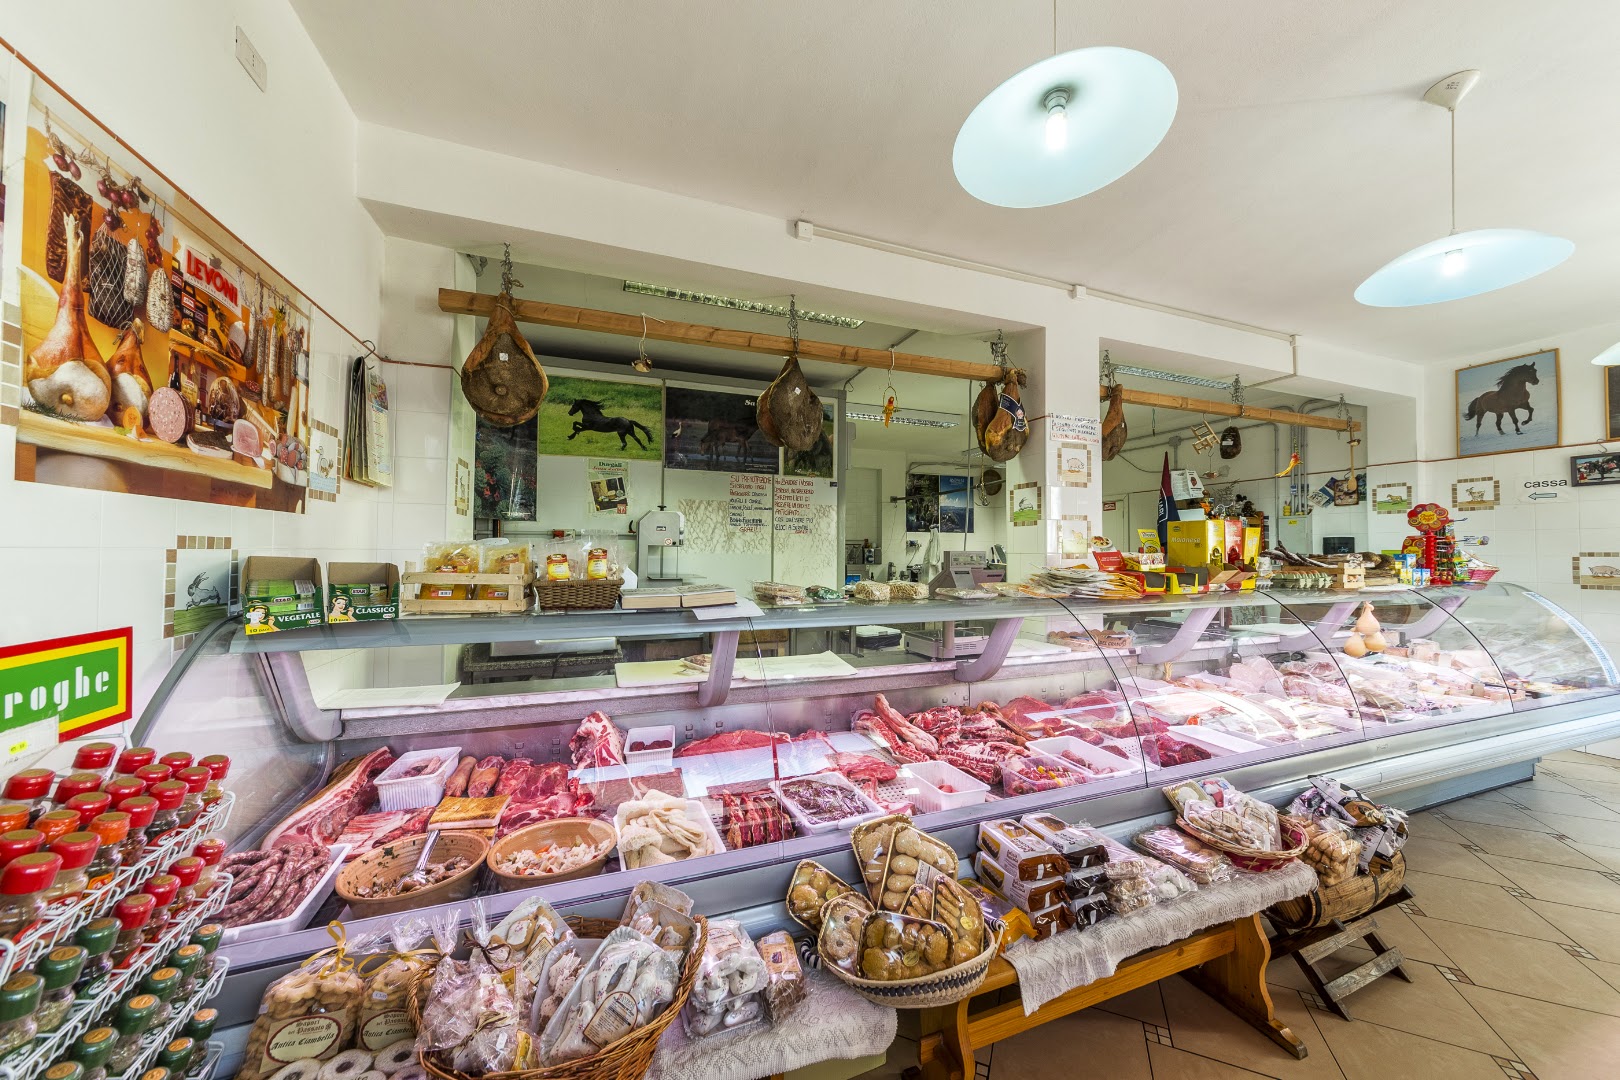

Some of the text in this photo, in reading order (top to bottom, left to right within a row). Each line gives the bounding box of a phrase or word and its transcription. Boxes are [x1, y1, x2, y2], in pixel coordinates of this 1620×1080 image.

[187, 249, 238, 307] LEVONI
[1523, 479, 1568, 489] cassa
[355, 606, 396, 615] CLASSICO
[277, 611, 321, 622] VEGETALE
[4, 665, 110, 720] roghe
[271, 1038, 296, 1050] Antica
